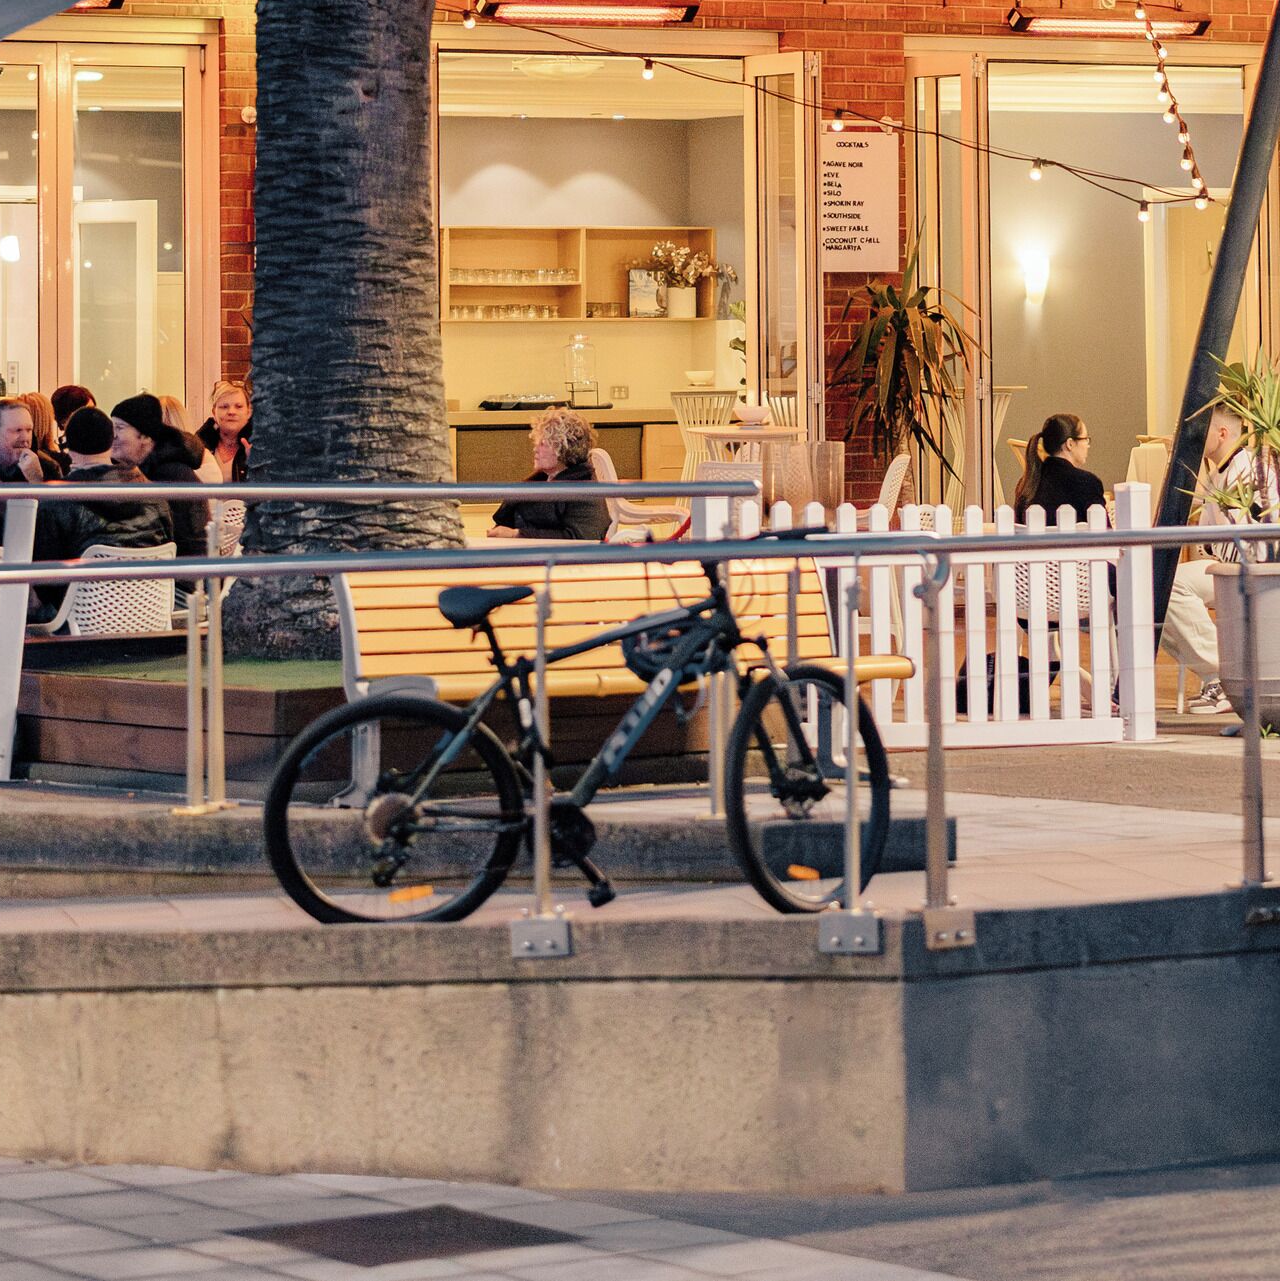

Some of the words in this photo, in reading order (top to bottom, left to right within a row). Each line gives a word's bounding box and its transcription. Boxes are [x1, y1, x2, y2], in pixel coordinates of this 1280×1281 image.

[825, 160, 847, 168] AGAVE
[826, 212, 861, 220] SOUTHSIDE
[825, 244, 862, 252] MARGARITA
